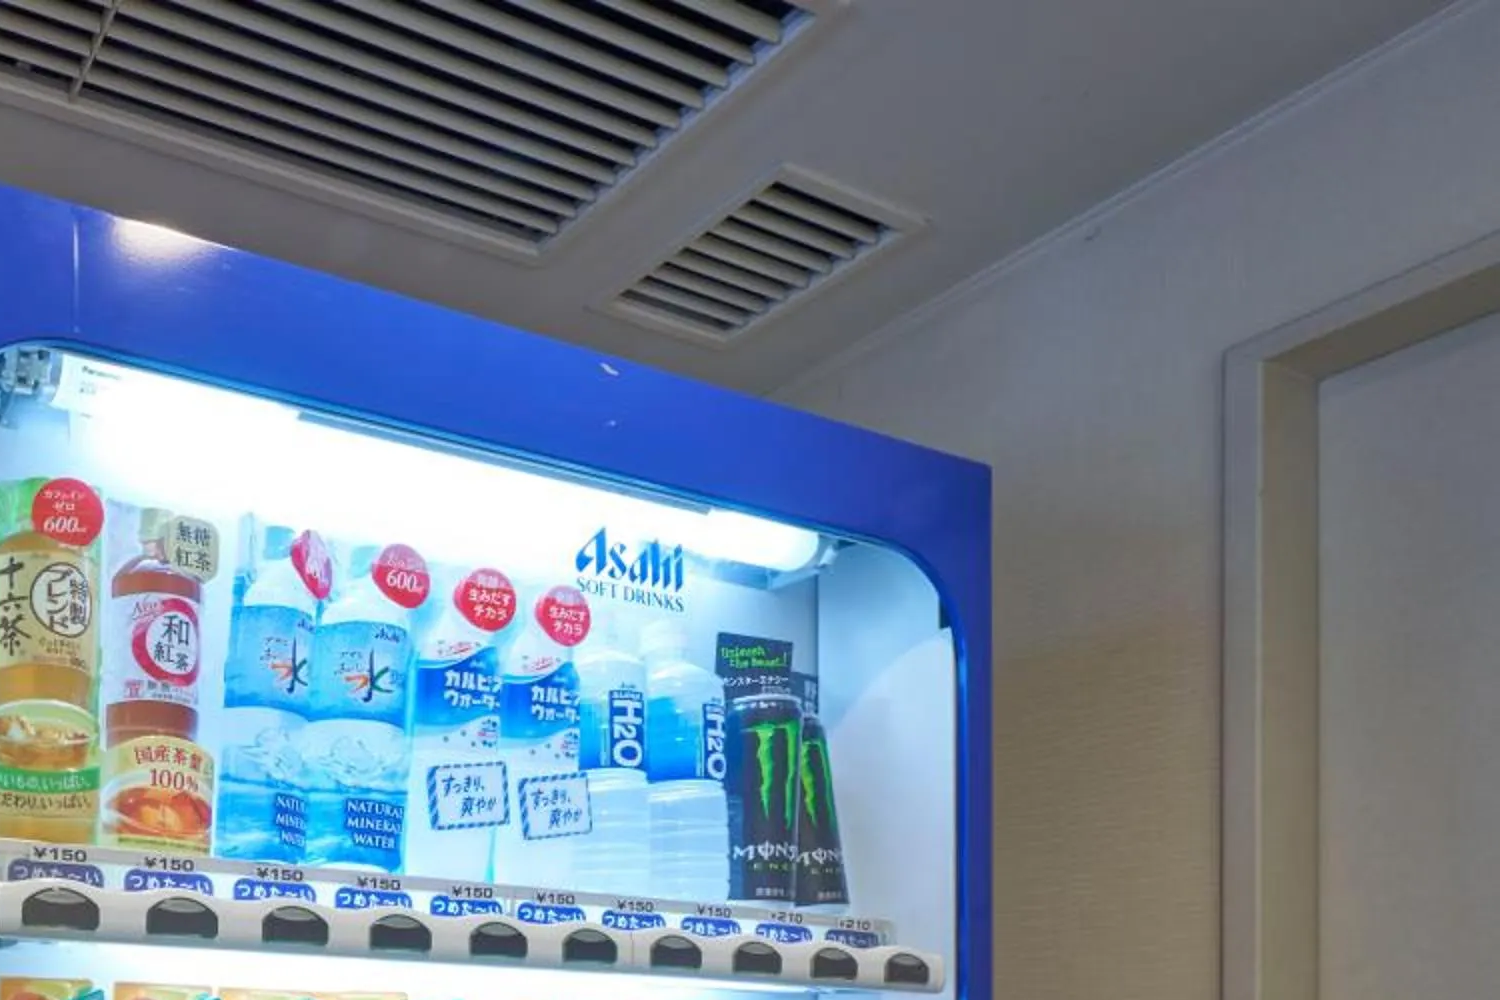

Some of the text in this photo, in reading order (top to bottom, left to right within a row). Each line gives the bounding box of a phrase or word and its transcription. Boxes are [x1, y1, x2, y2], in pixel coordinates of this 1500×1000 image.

[175, 546, 211, 572] 紅茶
[575, 526, 684, 592] Asahi
[44, 567, 73, 632] ブレンド
[576, 577, 617, 599] SOFT
[623, 586, 684, 612] DRINKS
[161, 613, 189, 646] 和
[154, 641, 189, 671] 紅茶
[443, 690, 500, 711] ウォータ
[531, 703, 581, 723] ウォータ
[612, 699, 643, 768] H2O
[150, 767, 199, 792] 100%
[460, 797, 498, 818] 爽やか
[548, 809, 584, 830] 爽やか
[353, 832, 397, 849] WATER
[33, 846, 87, 864] ¥150
[144, 856, 194, 873] ¥150
[257, 866, 304, 882] ¥150
[357, 876, 401, 891] ¥150
[452, 886, 493, 899] ¥150
[536, 893, 576, 906] ¥150
[617, 900, 655, 913] ¥150
[696, 905, 733, 918] ¥150
